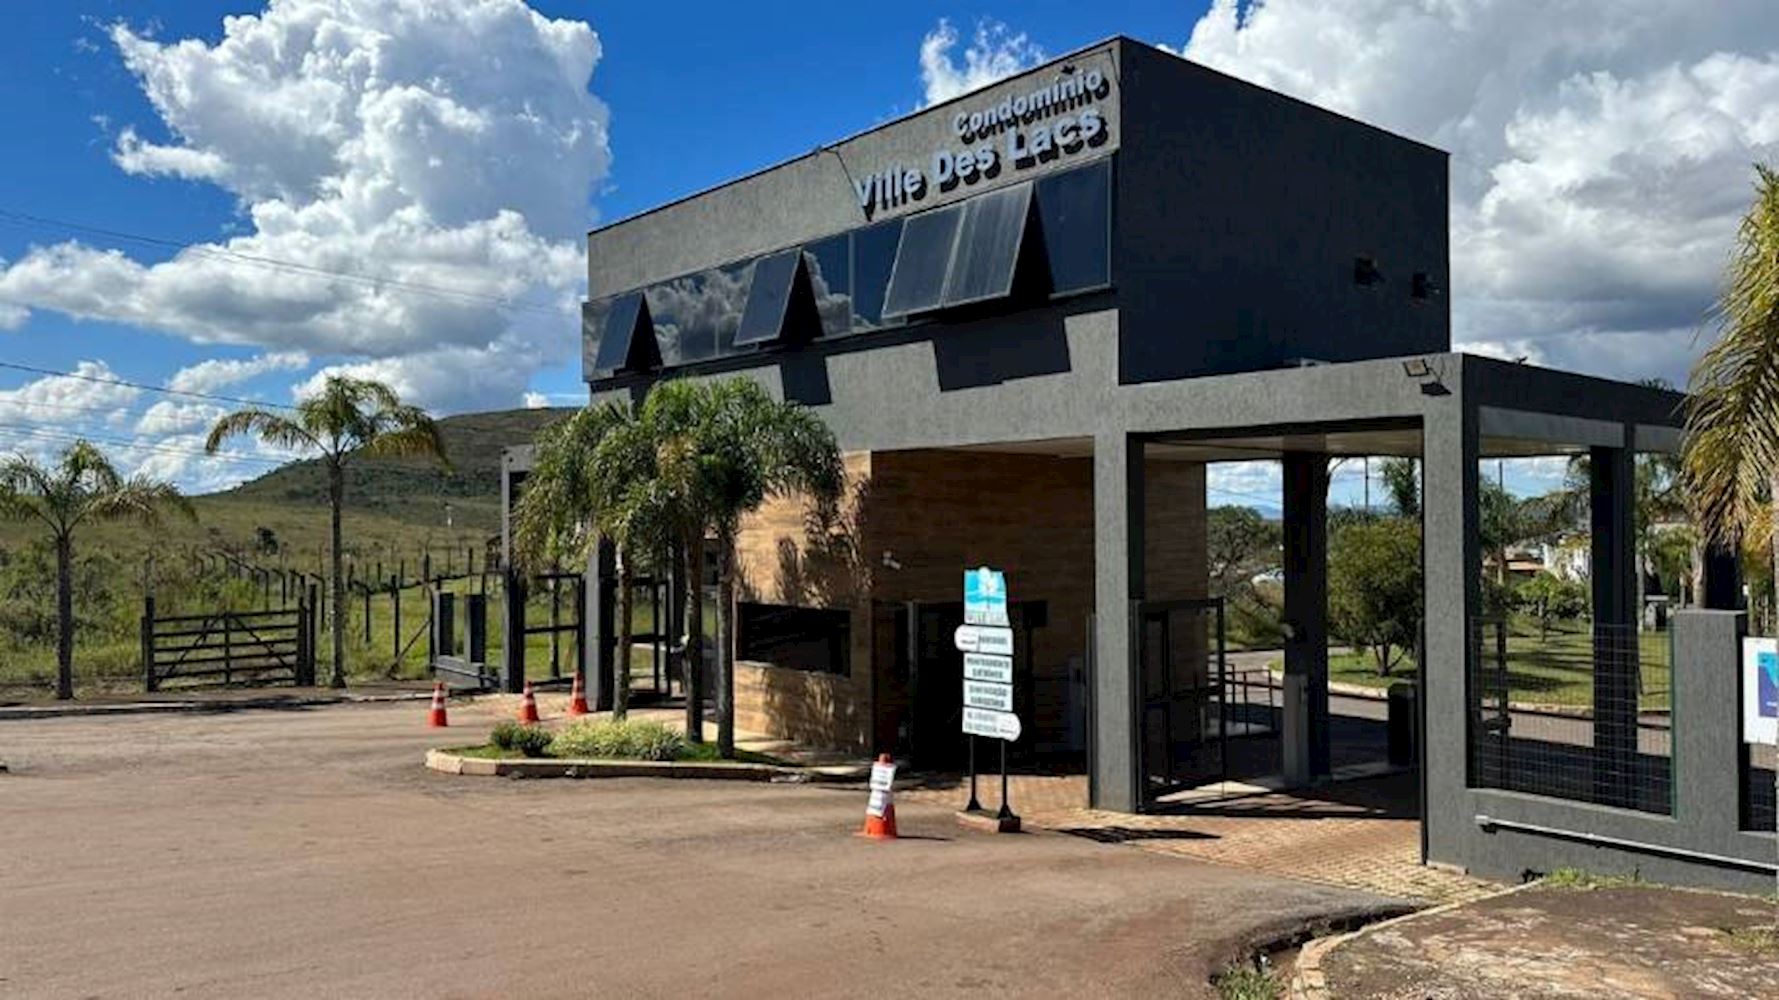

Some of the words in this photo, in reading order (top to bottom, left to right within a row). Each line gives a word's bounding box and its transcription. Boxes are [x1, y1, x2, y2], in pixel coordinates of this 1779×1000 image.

[856, 166, 922, 207] Ville
[931, 147, 997, 185] Des
[1008, 110, 1102, 159] Lacs
